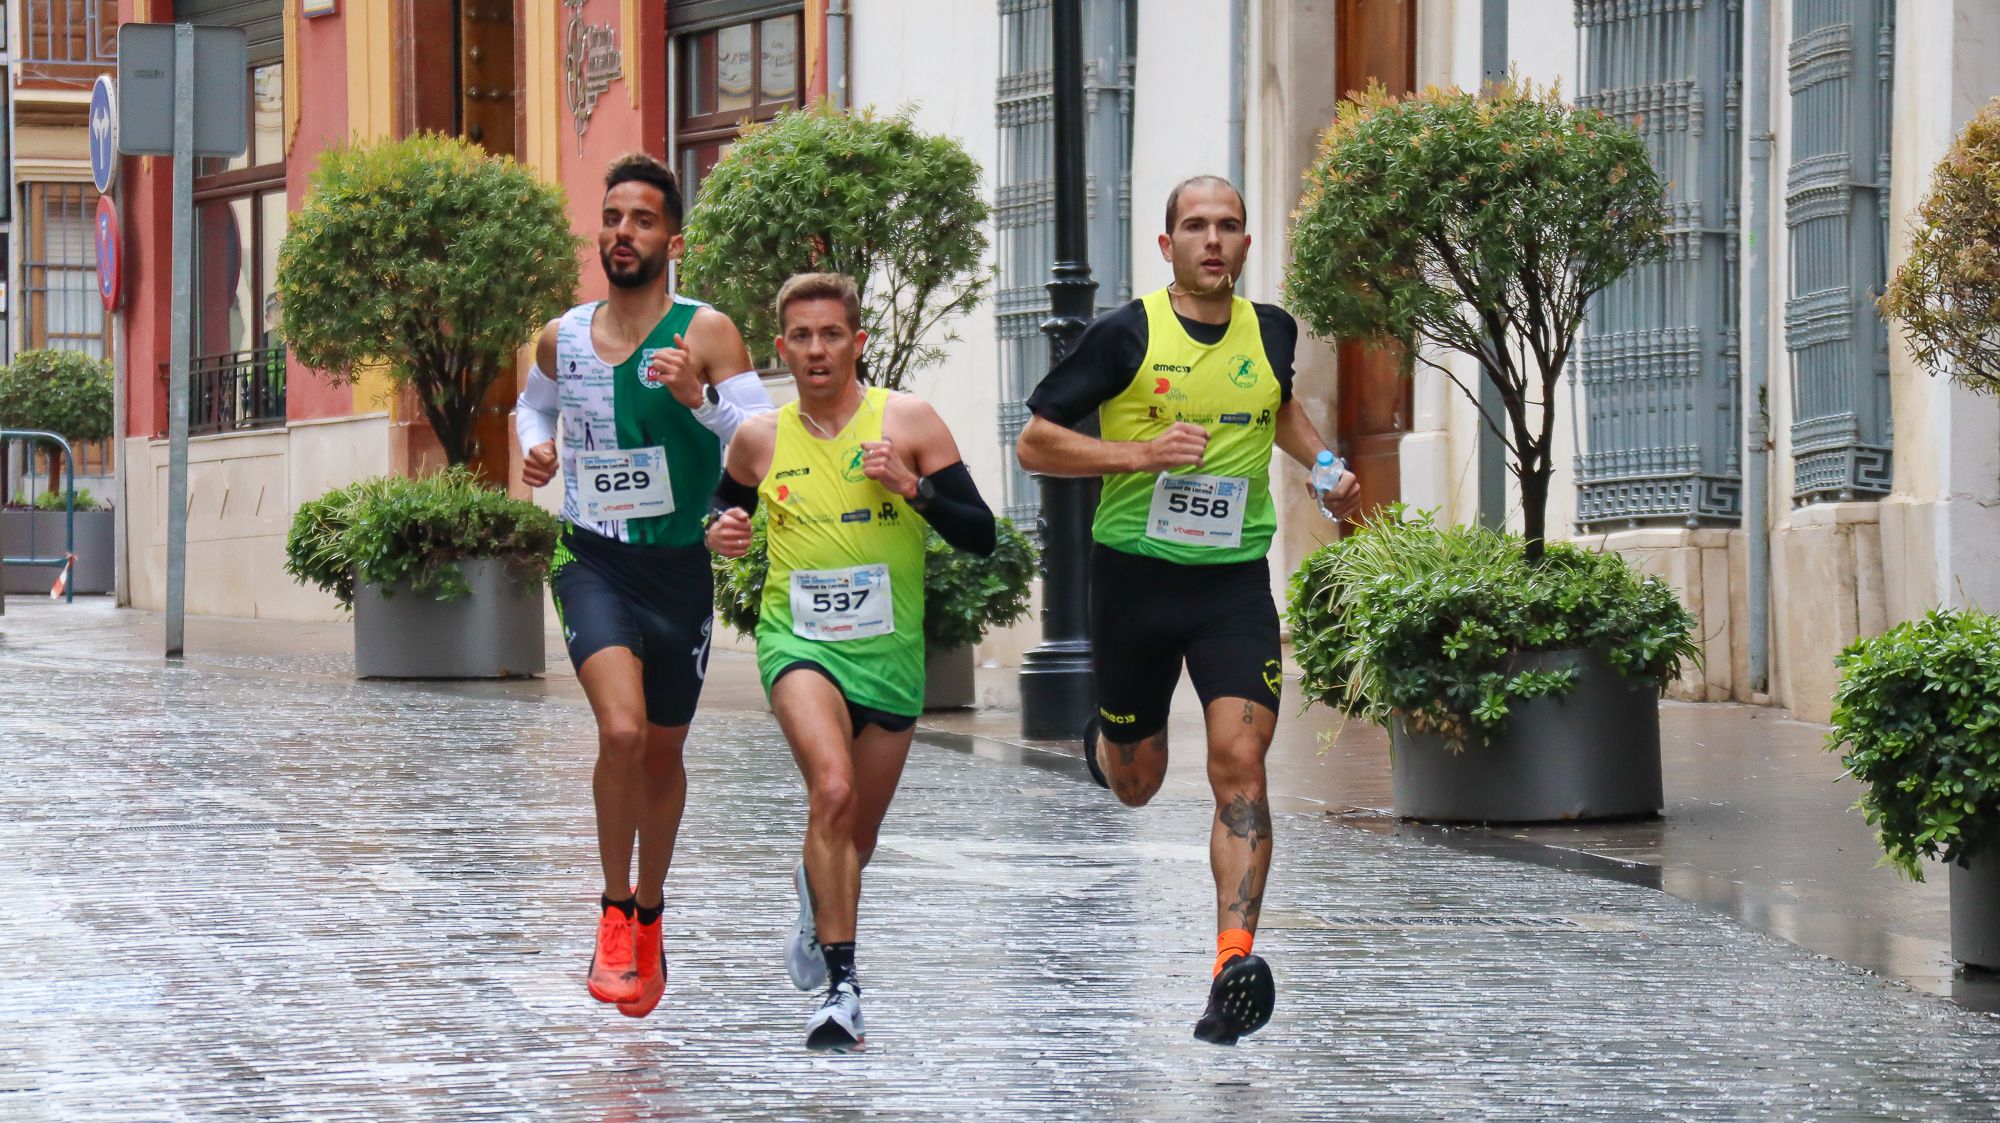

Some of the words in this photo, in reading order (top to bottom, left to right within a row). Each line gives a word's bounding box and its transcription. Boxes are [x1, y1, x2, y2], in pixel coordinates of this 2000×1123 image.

[594, 470, 650, 493] 629
[1168, 492, 1229, 519] 558
[813, 589, 870, 613] 537
